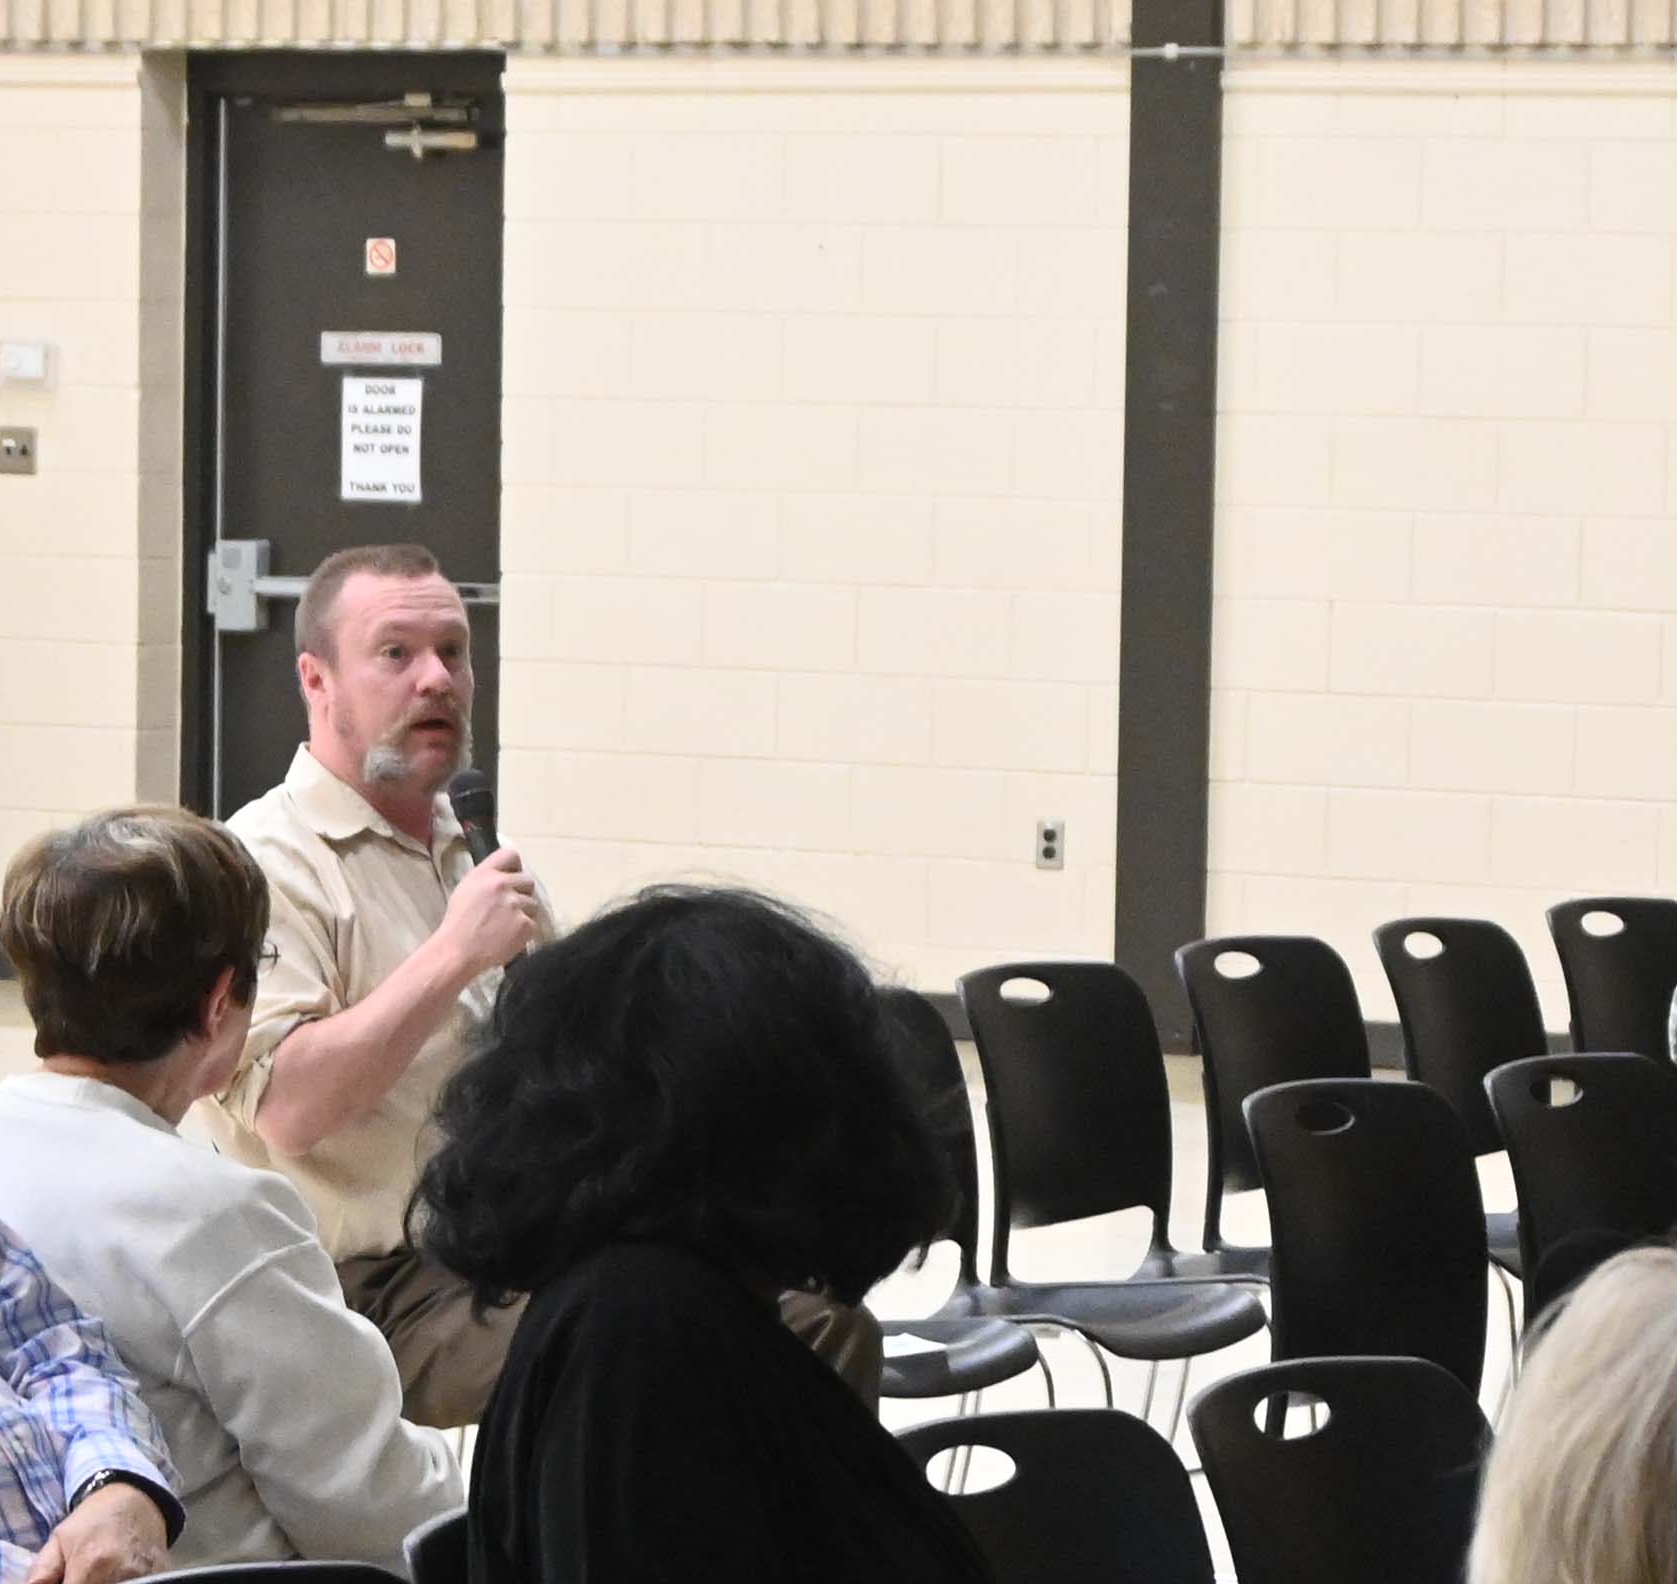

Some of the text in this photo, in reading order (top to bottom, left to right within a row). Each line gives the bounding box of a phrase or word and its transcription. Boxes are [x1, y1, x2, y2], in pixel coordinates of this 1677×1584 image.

[391, 341, 425, 353] LOCK
[365, 384, 396, 395] DOOR
[348, 404, 416, 415] IS ALARMED
[351, 423, 412, 435] PLEASE DO
[354, 443, 409, 455] NOT OPEN
[350, 481, 415, 494] THANK YOU
